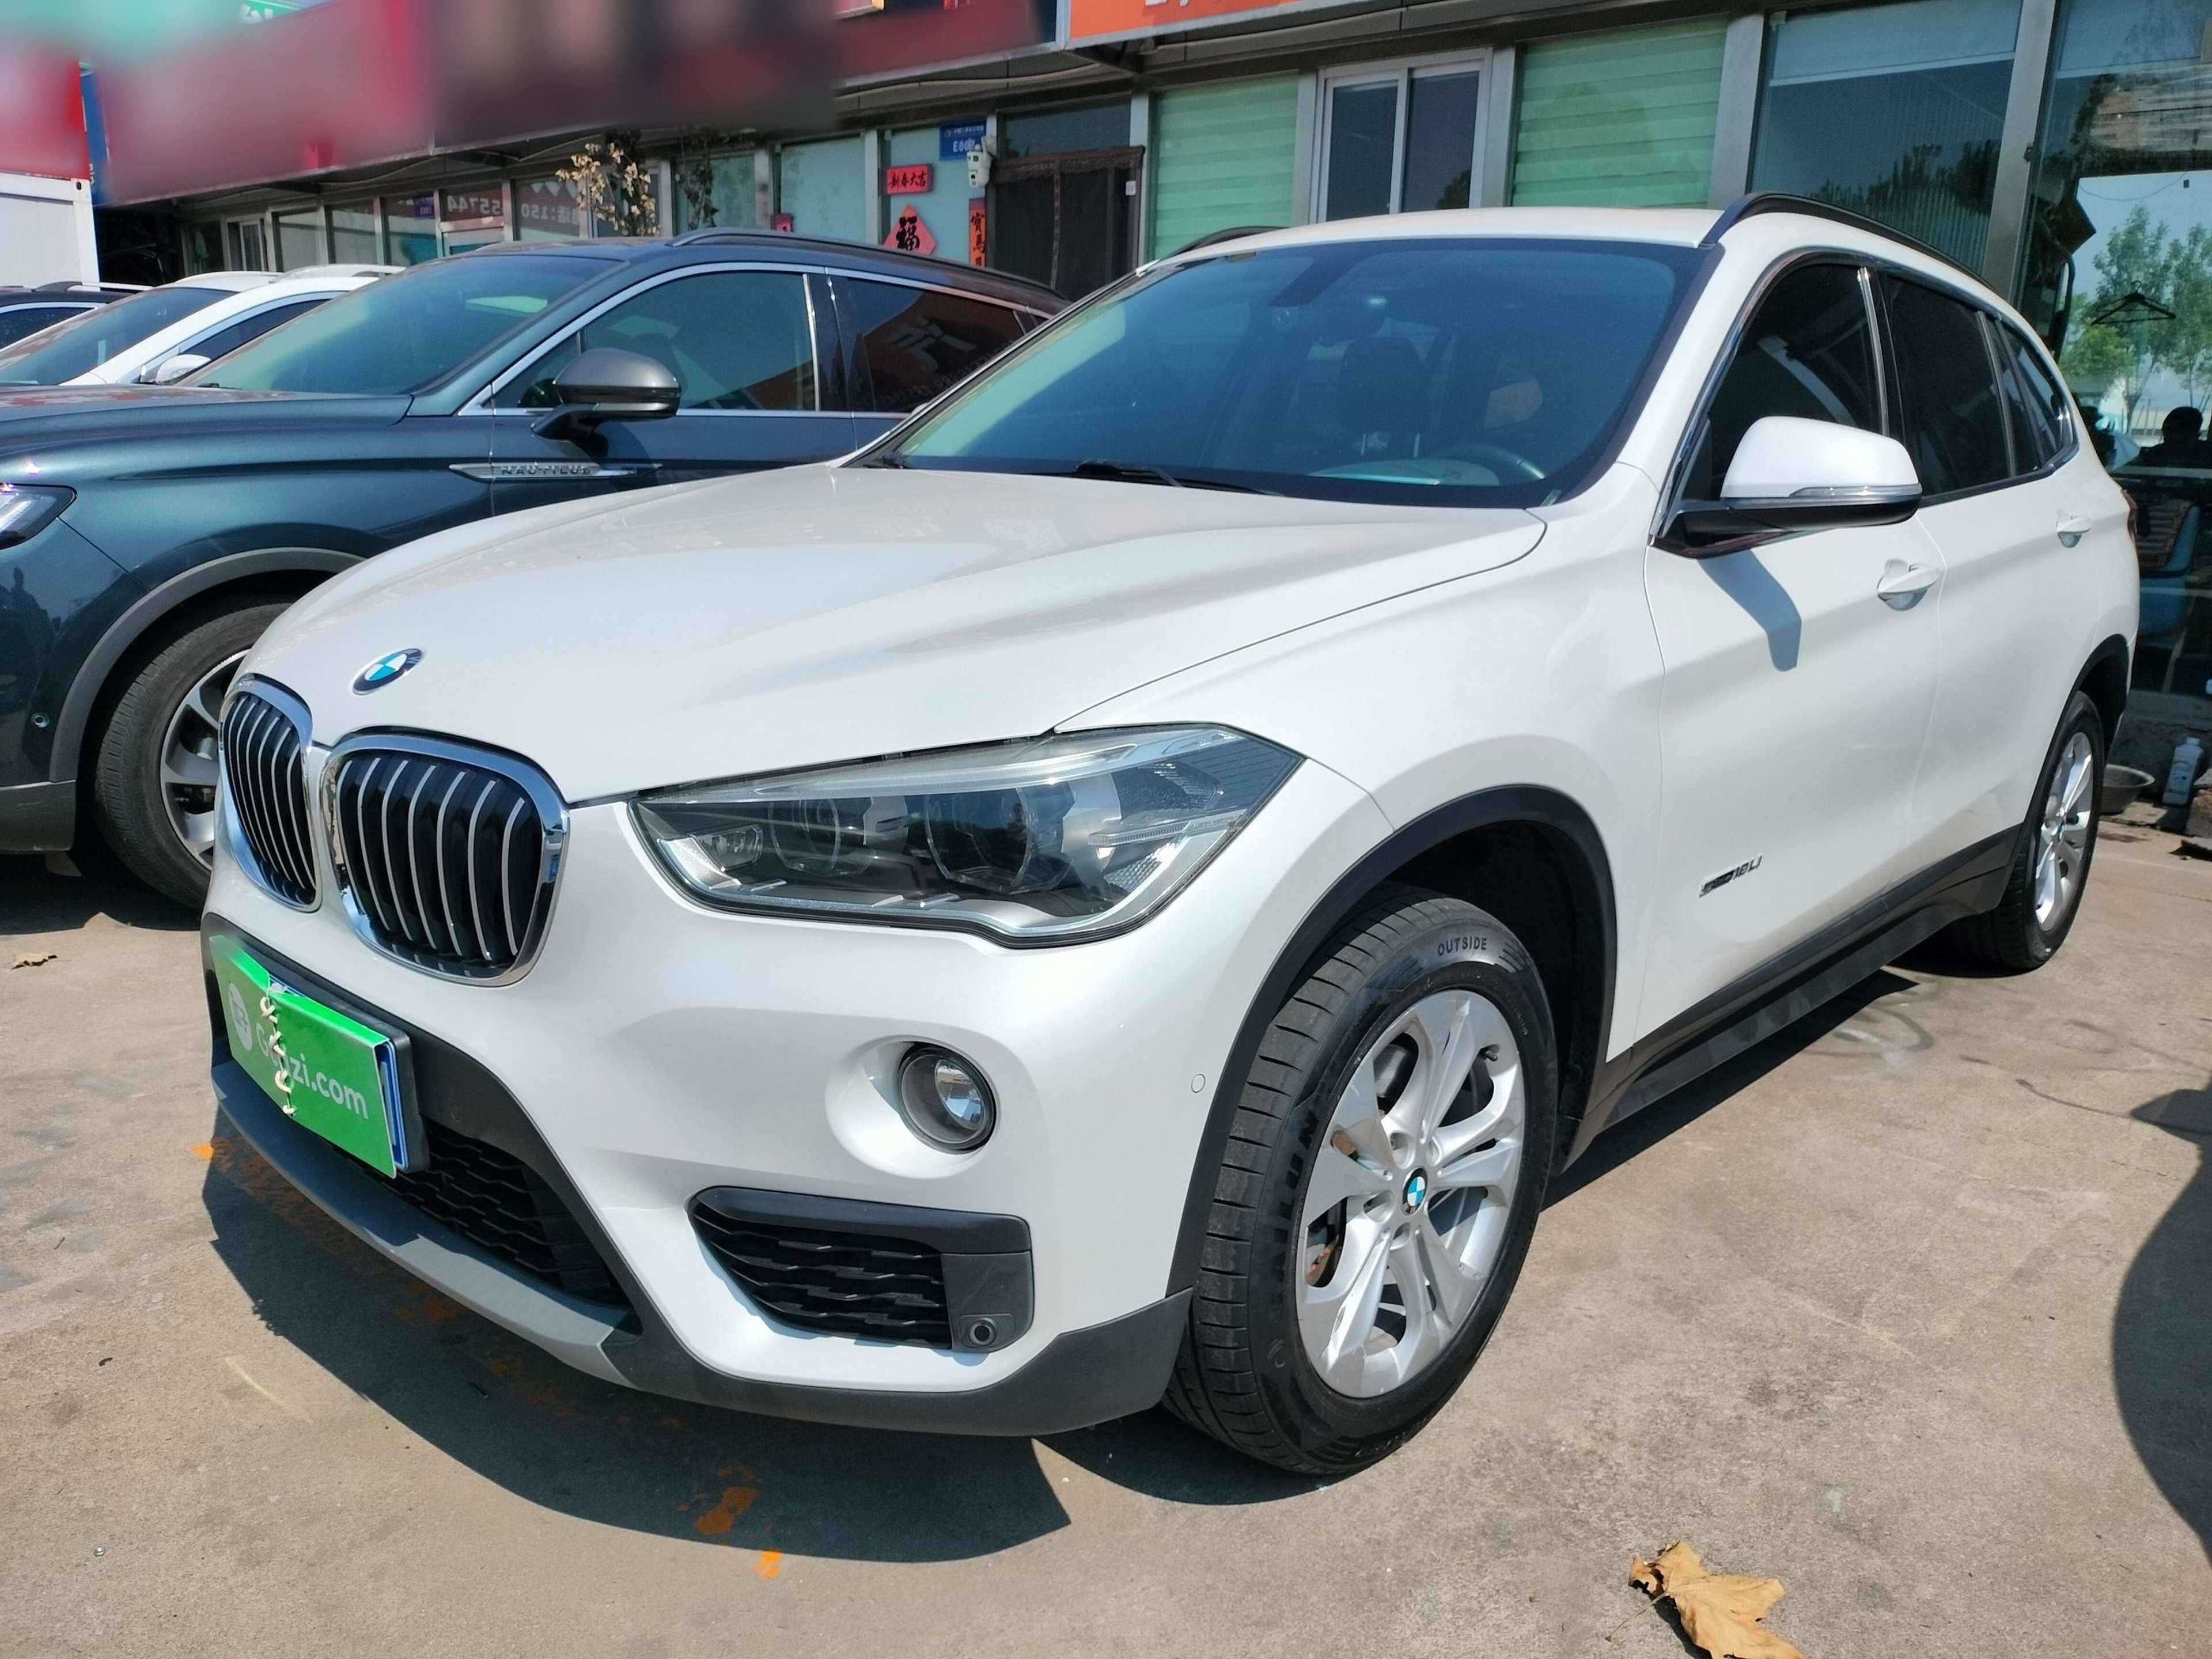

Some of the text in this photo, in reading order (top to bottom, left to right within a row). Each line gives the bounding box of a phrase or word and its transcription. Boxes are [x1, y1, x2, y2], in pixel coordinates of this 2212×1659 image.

[888, 170, 926, 190] 新春大吉
[896, 216, 921, 251] 福
[501, 464, 590, 475] NAUTILUS
[1437, 936, 1487, 957] OUTSIDE
[256, 1022, 369, 1119] Gzi.com
